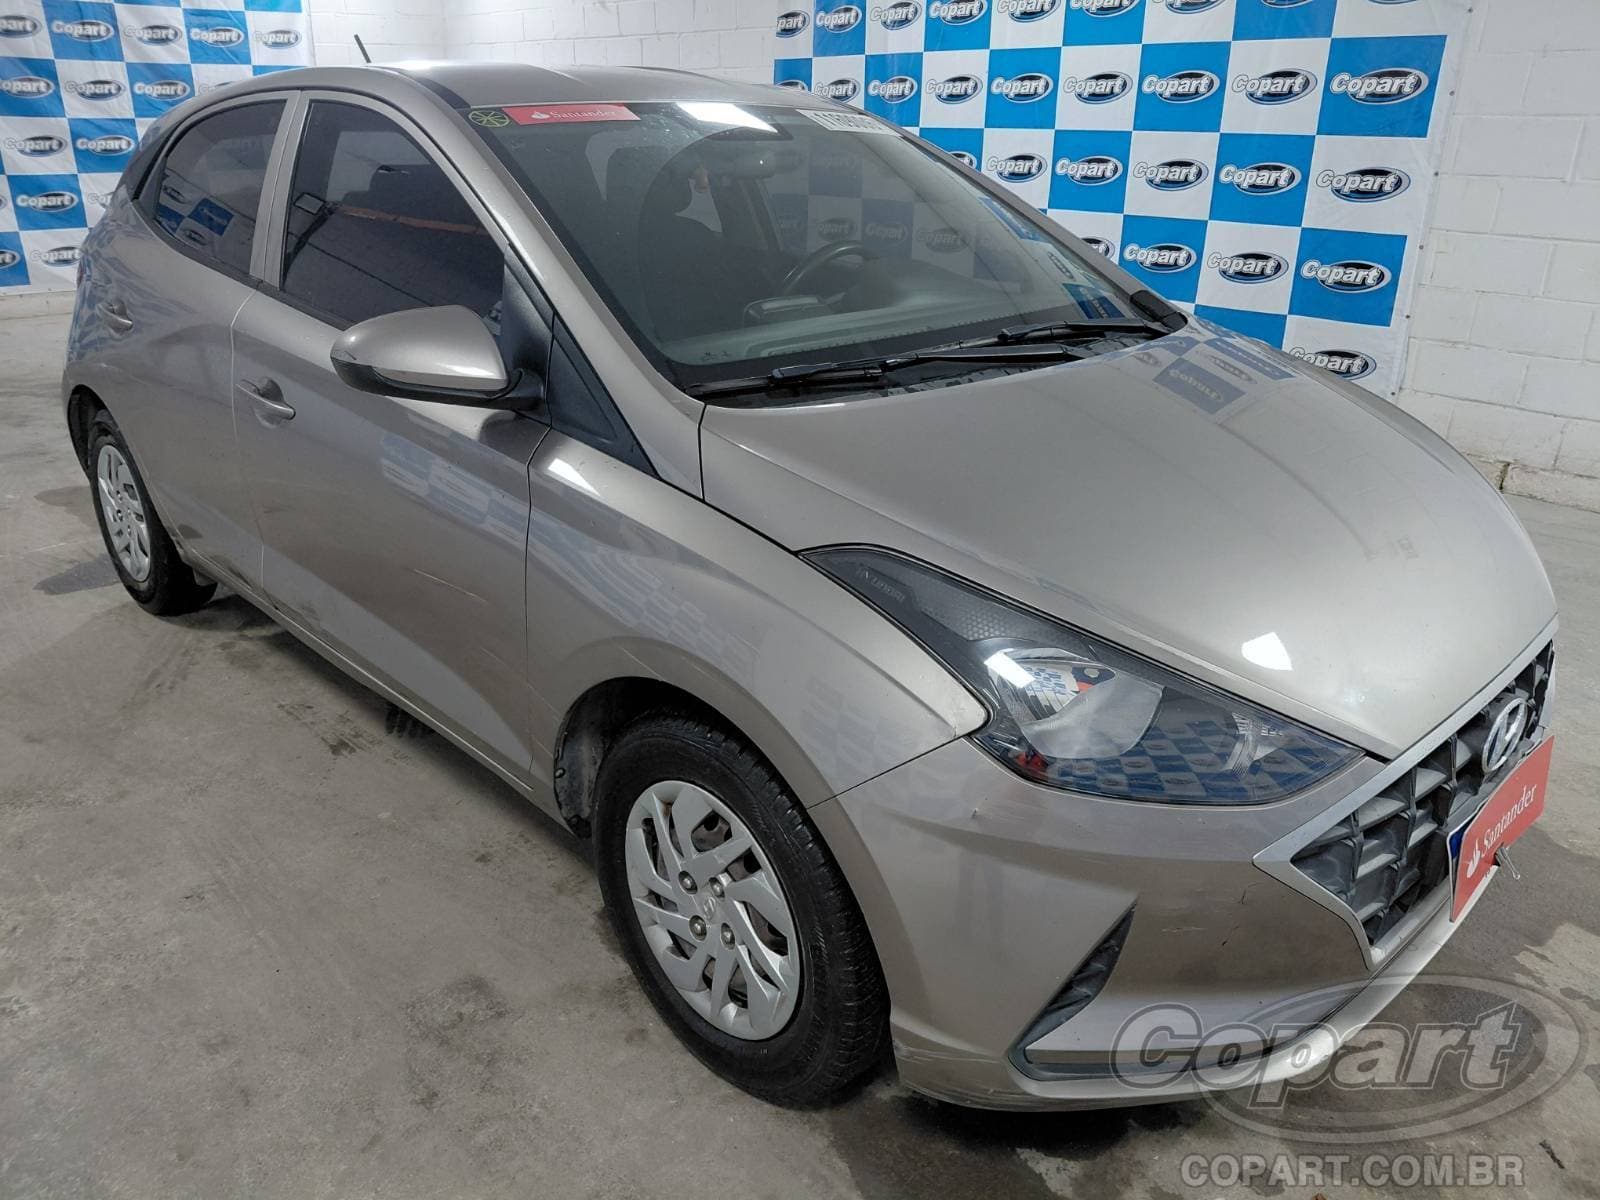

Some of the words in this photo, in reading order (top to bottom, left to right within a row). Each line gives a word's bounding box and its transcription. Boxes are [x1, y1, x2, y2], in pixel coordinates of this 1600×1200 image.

[815, 9, 858, 28] Copart
[870, 4, 915, 26] Copart
[929, 0, 980, 20] Copart
[997, 0, 1052, 17] Copart
[0, 19, 34, 33] part
[51, 21, 108, 37] Copart
[125, 26, 175, 41] Copart
[776, 16, 804, 31] part
[190, 28, 239, 42] Copart
[254, 31, 298, 45] Copart
[0, 81, 48, 97] opart
[64, 81, 118, 96] Copart
[133, 82, 182, 97] Copart
[814, 80, 854, 98] Copart
[868, 79, 911, 99] Copart
[926, 78, 975, 98] Copart
[991, 76, 1047, 98] Copart
[1063, 75, 1122, 97] Copart
[1142, 73, 1211, 95] Copart
[1231, 72, 1307, 96] Copart
[1330, 72, 1419, 98] Copart
[549, 110, 617, 119] Santander
[5, 137, 60, 153] Copart
[77, 138, 129, 153] Copart
[987, 156, 1038, 177] Copart
[1056, 158, 1115, 180] Copart
[1133, 161, 1200, 182] Copart
[1218, 164, 1290, 188] Copart
[1315, 170, 1399, 195] Copart
[16, 194, 72, 208] Copart
[1123, 243, 1188, 269] Copart
[1207, 251, 1276, 276] Copart
[1301, 259, 1382, 286] Copart
[1289, 346, 1364, 374] Copart
[1480, 784, 1538, 858] Santander
